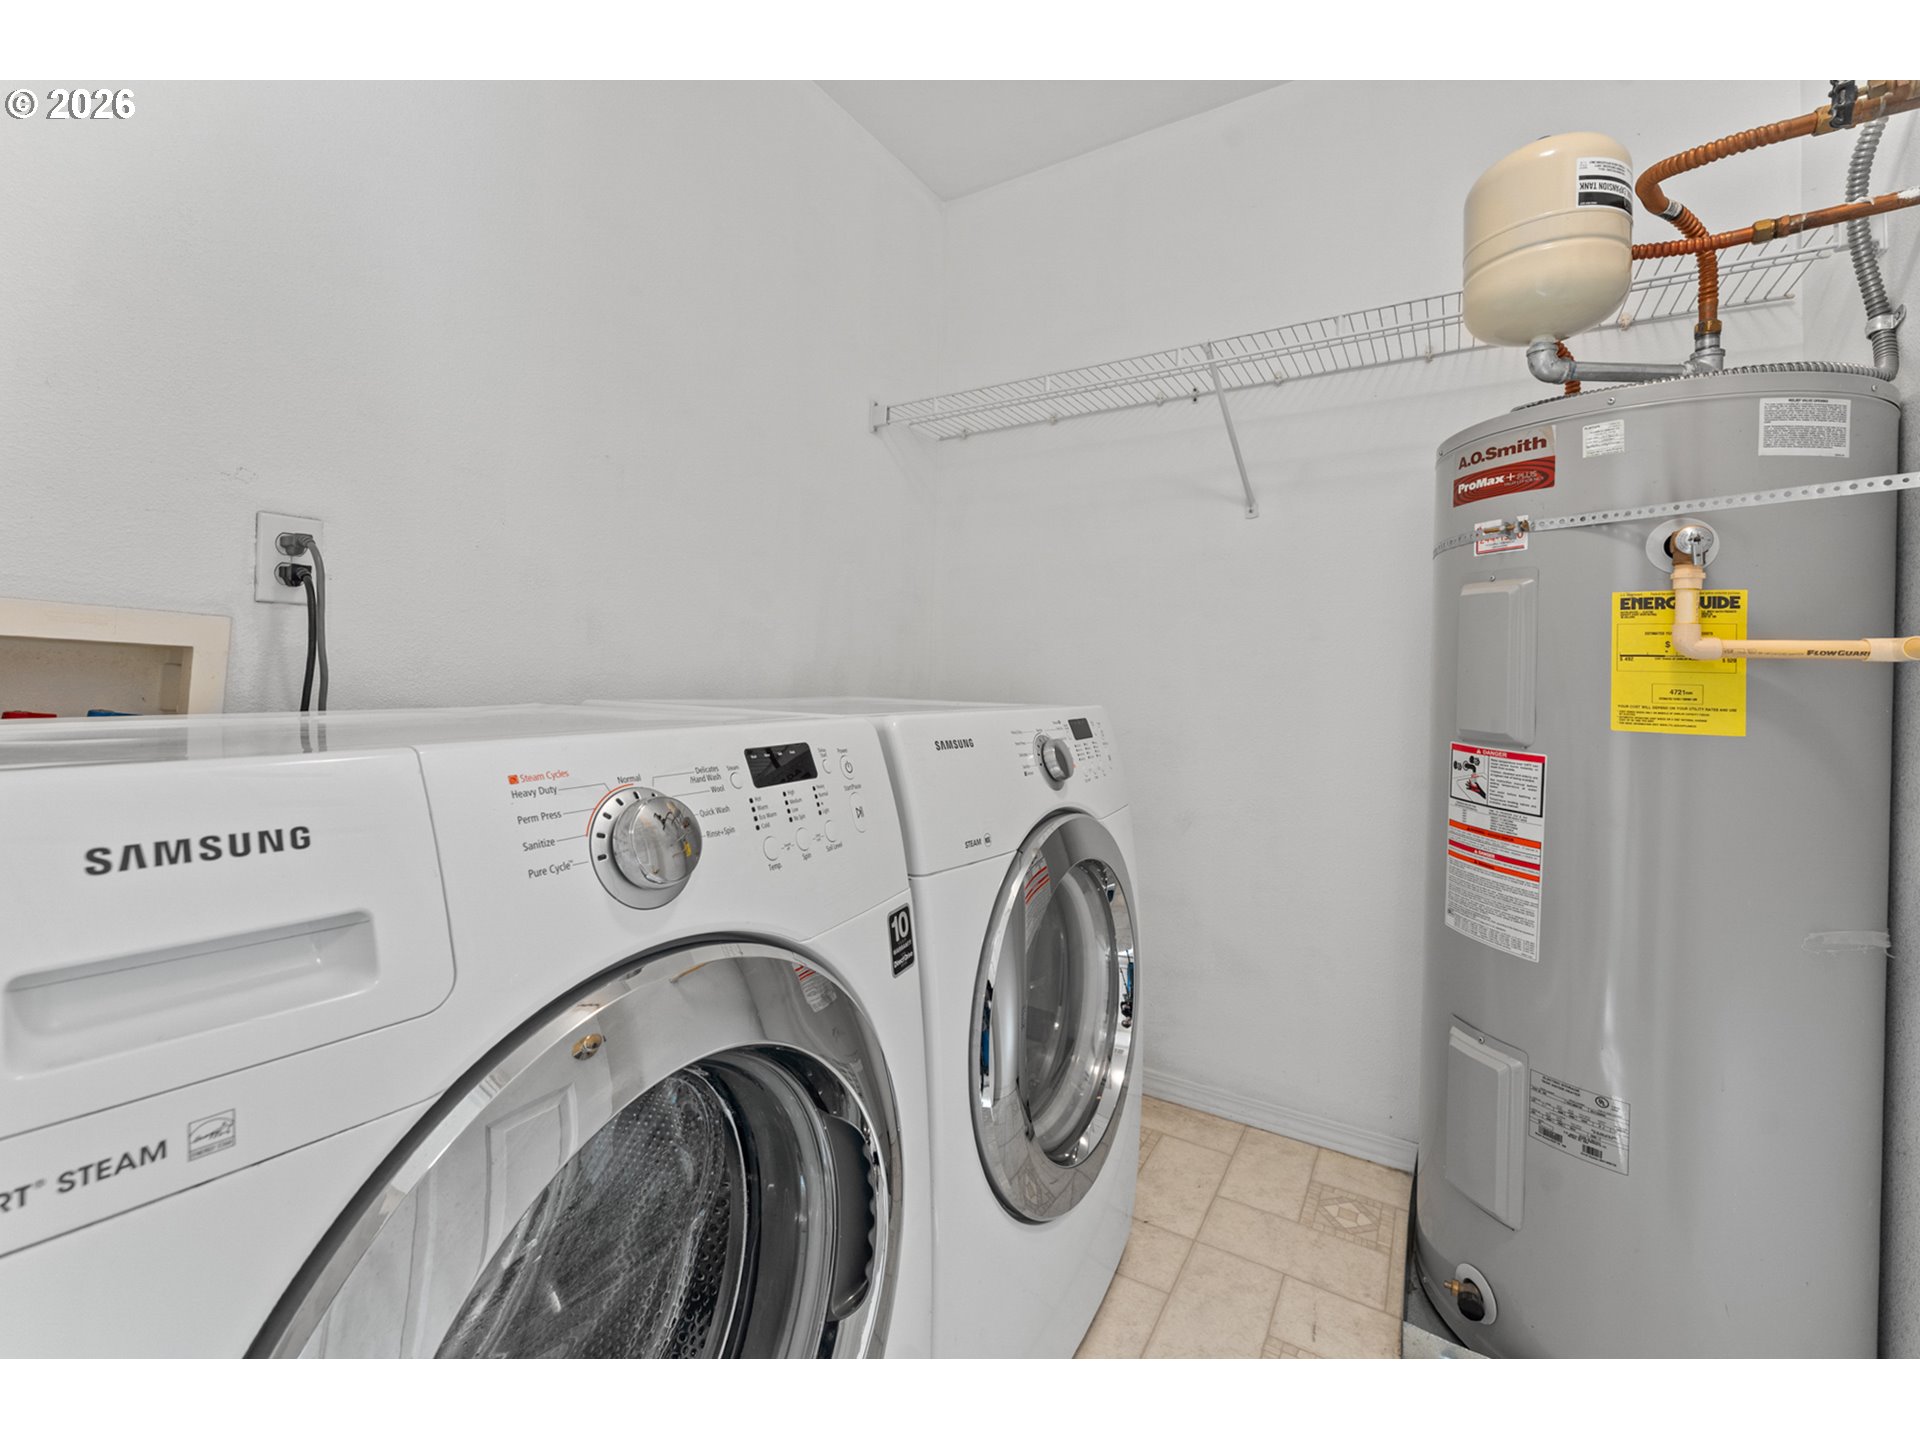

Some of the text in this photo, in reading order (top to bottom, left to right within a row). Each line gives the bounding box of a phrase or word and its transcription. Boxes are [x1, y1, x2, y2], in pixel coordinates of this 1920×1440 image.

[1579, 182, 1597, 190] TANK
[1458, 436, 1547, 470] A.O.Smith
[934, 738, 974, 751] SAMSUNG
[695, 765, 719, 774] Delicates
[520, 770, 569, 783] Steam Cycles
[617, 774, 641, 784] Normal
[707, 773, 721, 782] Wash
[511, 786, 557, 799] Heavy Duty
[711, 785, 725, 793] Wool
[517, 811, 562, 824] Perm Press
[699, 806, 730, 818] Quick Wash
[523, 837, 555, 851] Sanitize
[965, 838, 982, 849] STEAM
[84, 826, 311, 876] SAMSUNG
[528, 867, 547, 878] Pure
[891, 911, 909, 942] 10
[56, 1139, 168, 1194] STEAM
